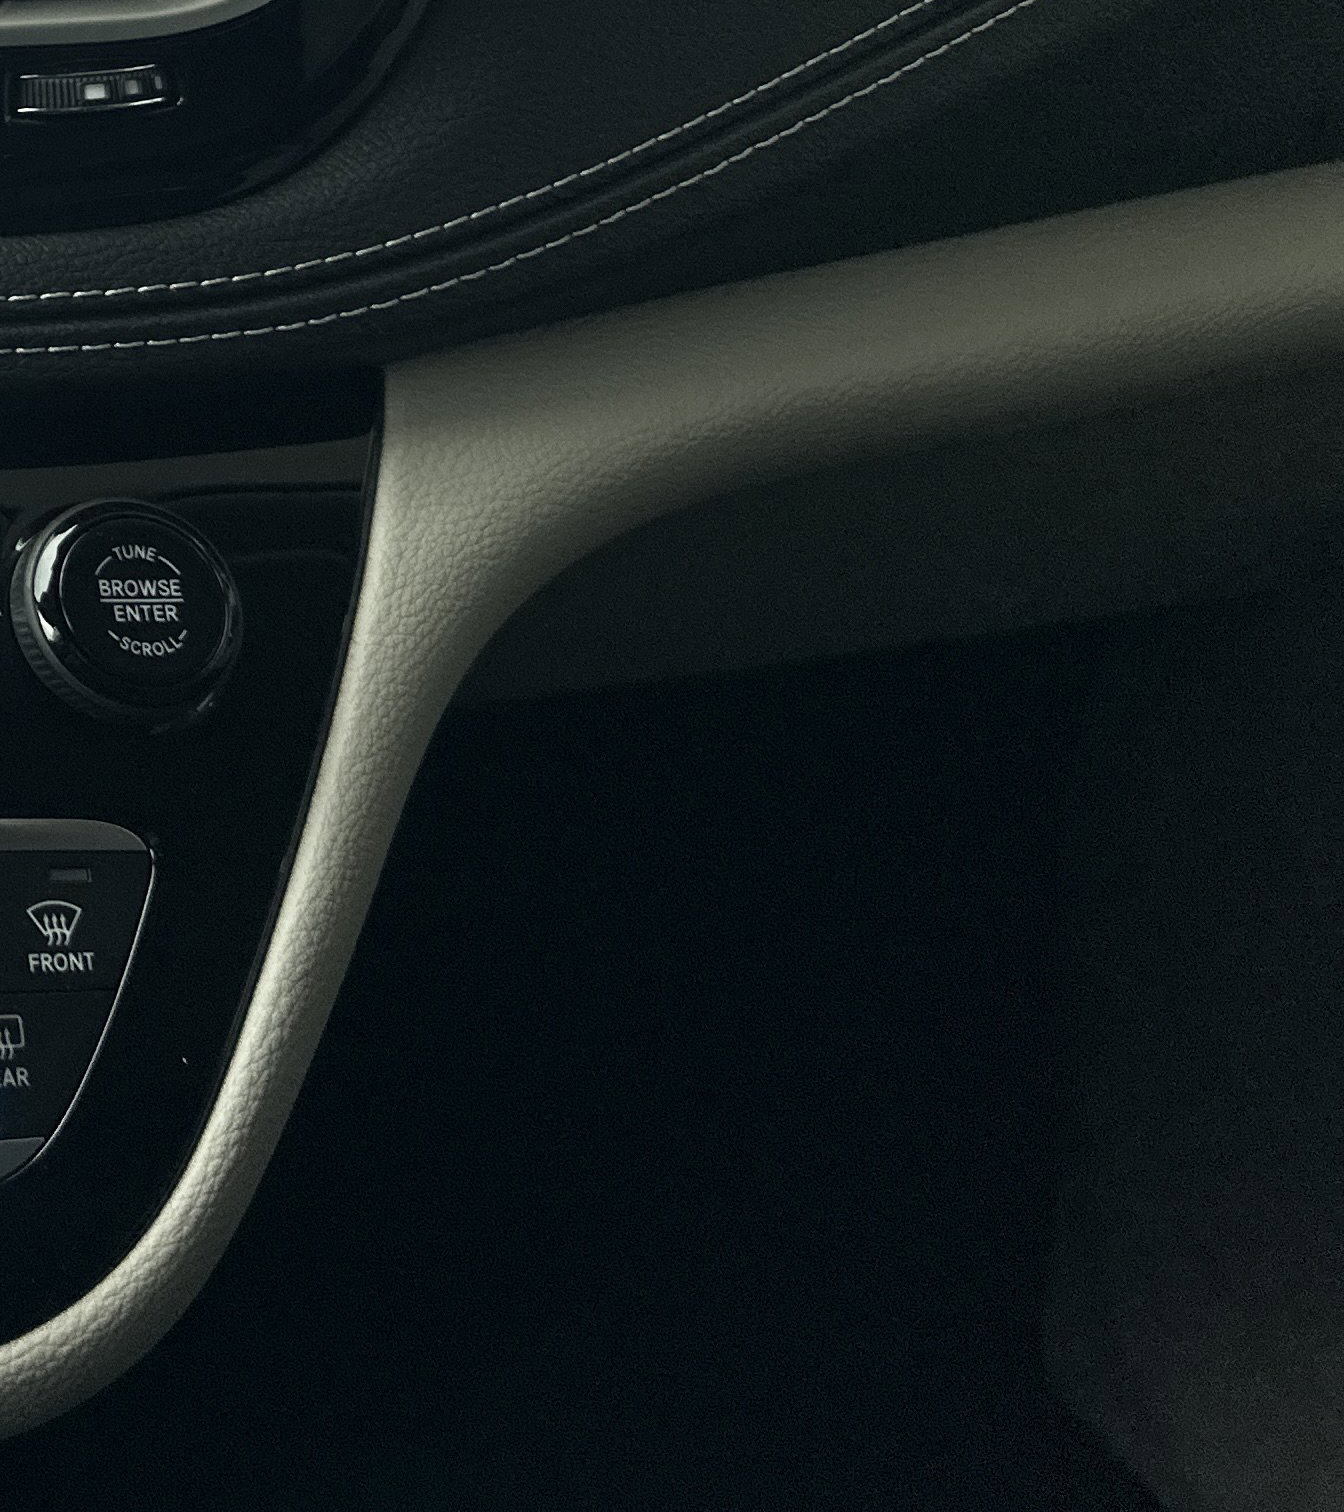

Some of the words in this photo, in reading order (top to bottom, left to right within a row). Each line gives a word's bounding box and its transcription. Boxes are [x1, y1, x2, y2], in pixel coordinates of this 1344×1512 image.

[112, 544, 157, 562] TUNE
[98, 578, 182, 597] BROWSE
[113, 604, 179, 622] ENTER
[121, 632, 184, 659] SCROLL
[28, 951, 94, 972] FRONT
